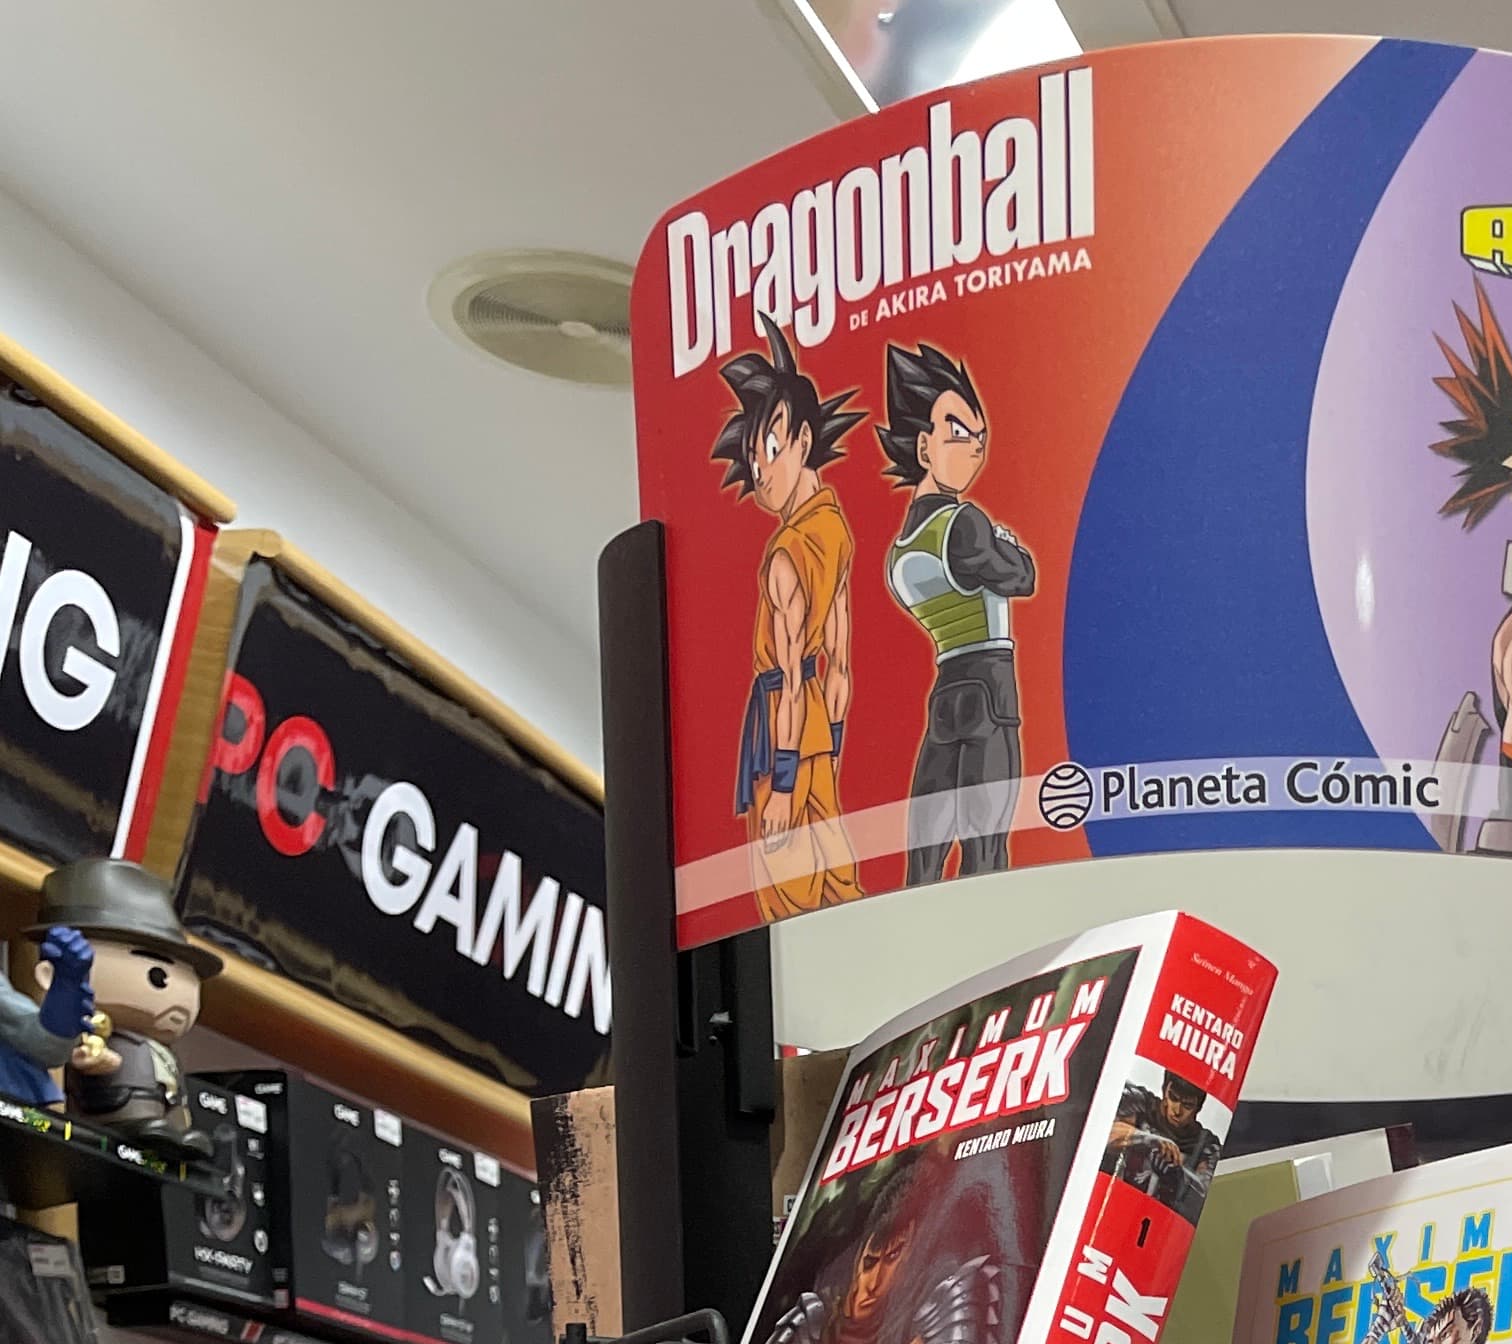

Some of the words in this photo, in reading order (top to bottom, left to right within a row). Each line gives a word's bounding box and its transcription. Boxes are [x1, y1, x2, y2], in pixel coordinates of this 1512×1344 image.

[667, 67, 1095, 379] Dragonball
[849, 308, 869, 332] DE
[875, 285, 947, 323] AKIRA
[954, 247, 1094, 298] TORIYAMA
[1103, 769, 1269, 814] Planeta
[1286, 758, 1440, 808] Cómic
[210, 673, 337, 857] PC
[360, 781, 613, 1035] GAMIN
[848, 977, 1105, 1109] MAXIMUM
[1159, 1014, 1237, 1081] MIURA
[1170, 993, 1244, 1046] KENTARO
[821, 1021, 1087, 1184] BERSERK
[954, 1129, 1010, 1161] KENTARO
[1013, 1118, 1056, 1146] MIURA
[1137, 1217, 1151, 1248] 1
